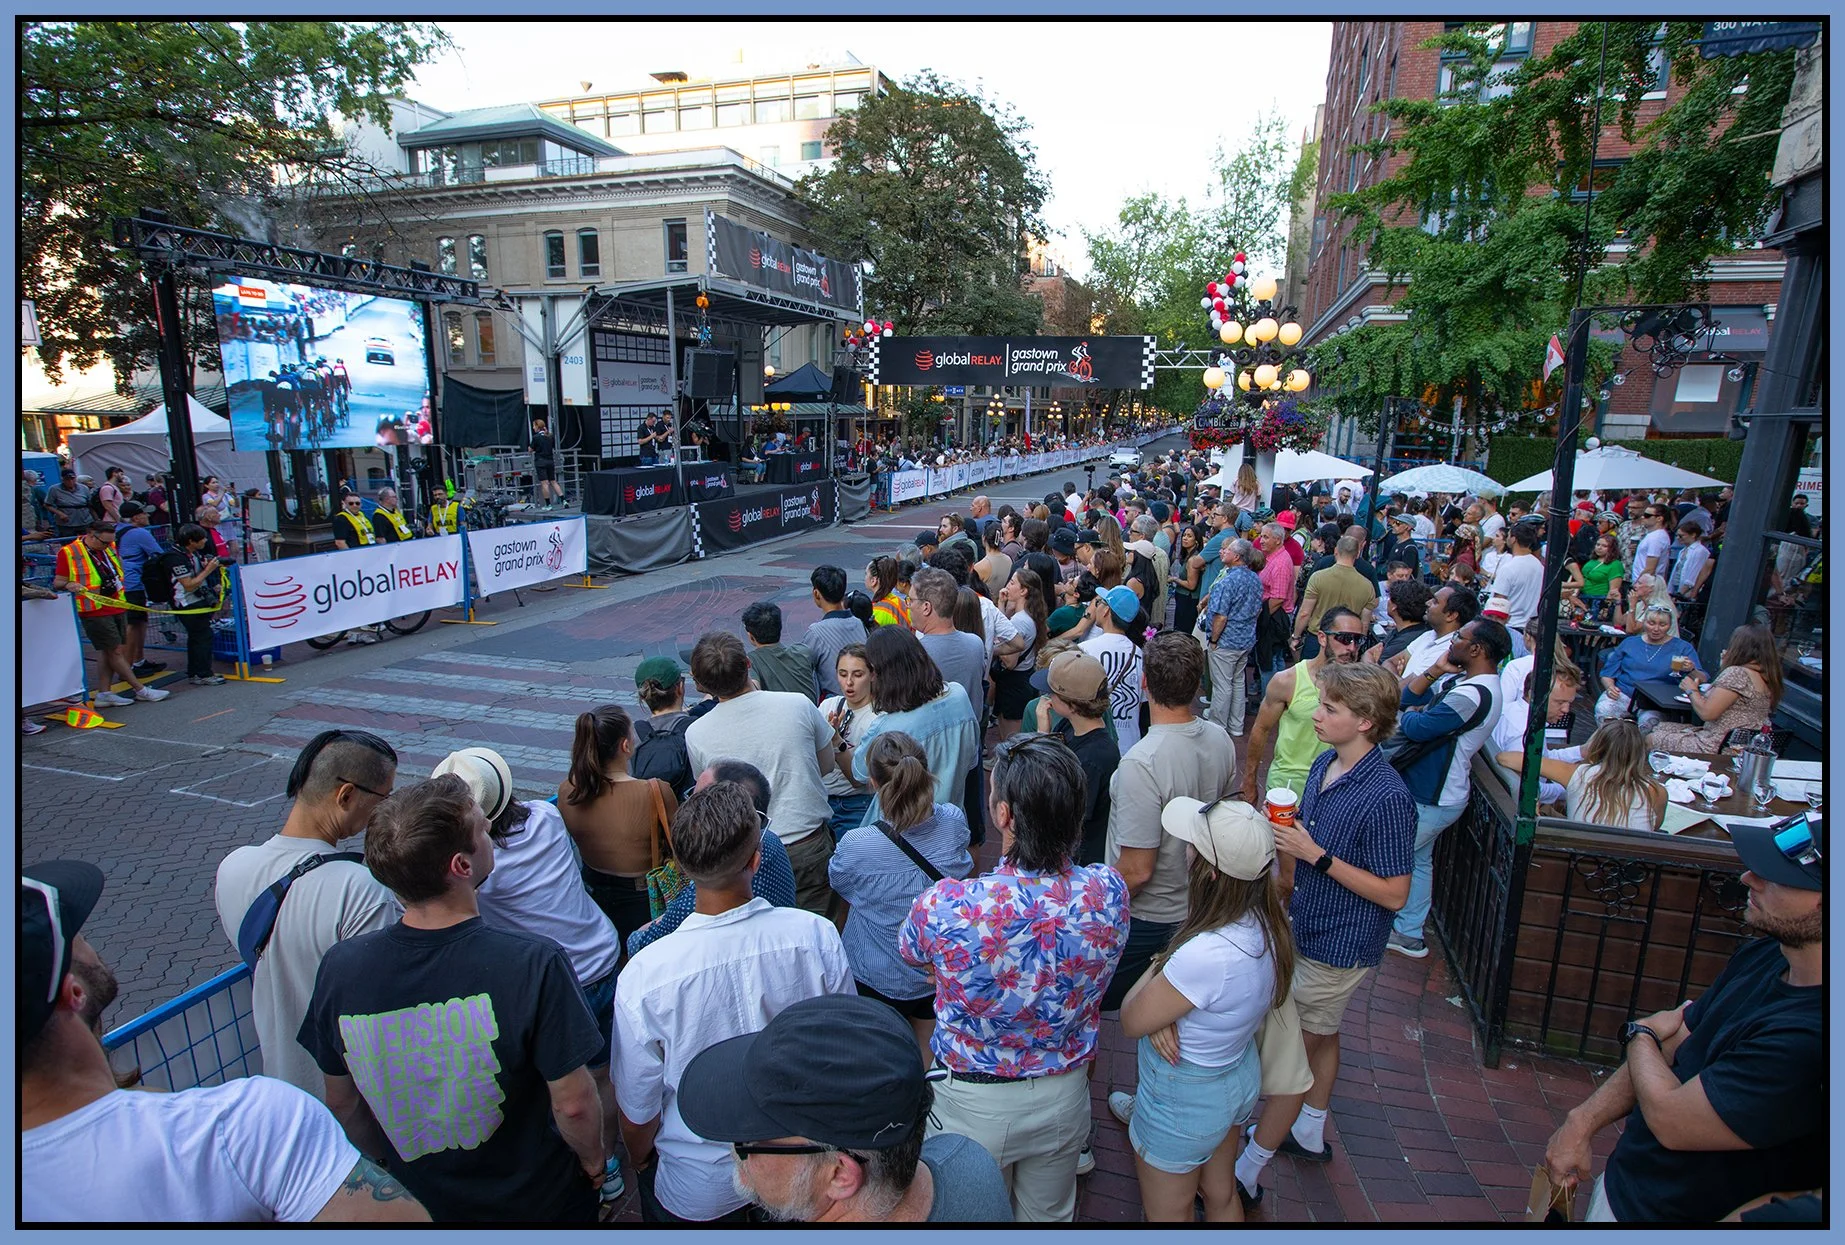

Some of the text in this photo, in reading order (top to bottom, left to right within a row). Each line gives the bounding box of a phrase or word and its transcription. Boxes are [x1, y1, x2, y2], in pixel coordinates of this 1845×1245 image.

[564, 356, 583, 364] 2403
[1012, 348, 1059, 361] gastown
[1012, 360, 1067, 374] grand prix
[784, 496, 806, 510] gastown
[784, 506, 801, 522] grand
[494, 540, 537, 560] gastown
[174, 565, 187, 574] 85
[494, 552, 544, 577] grand prix
[342, 998, 494, 1057] DIVERSION
